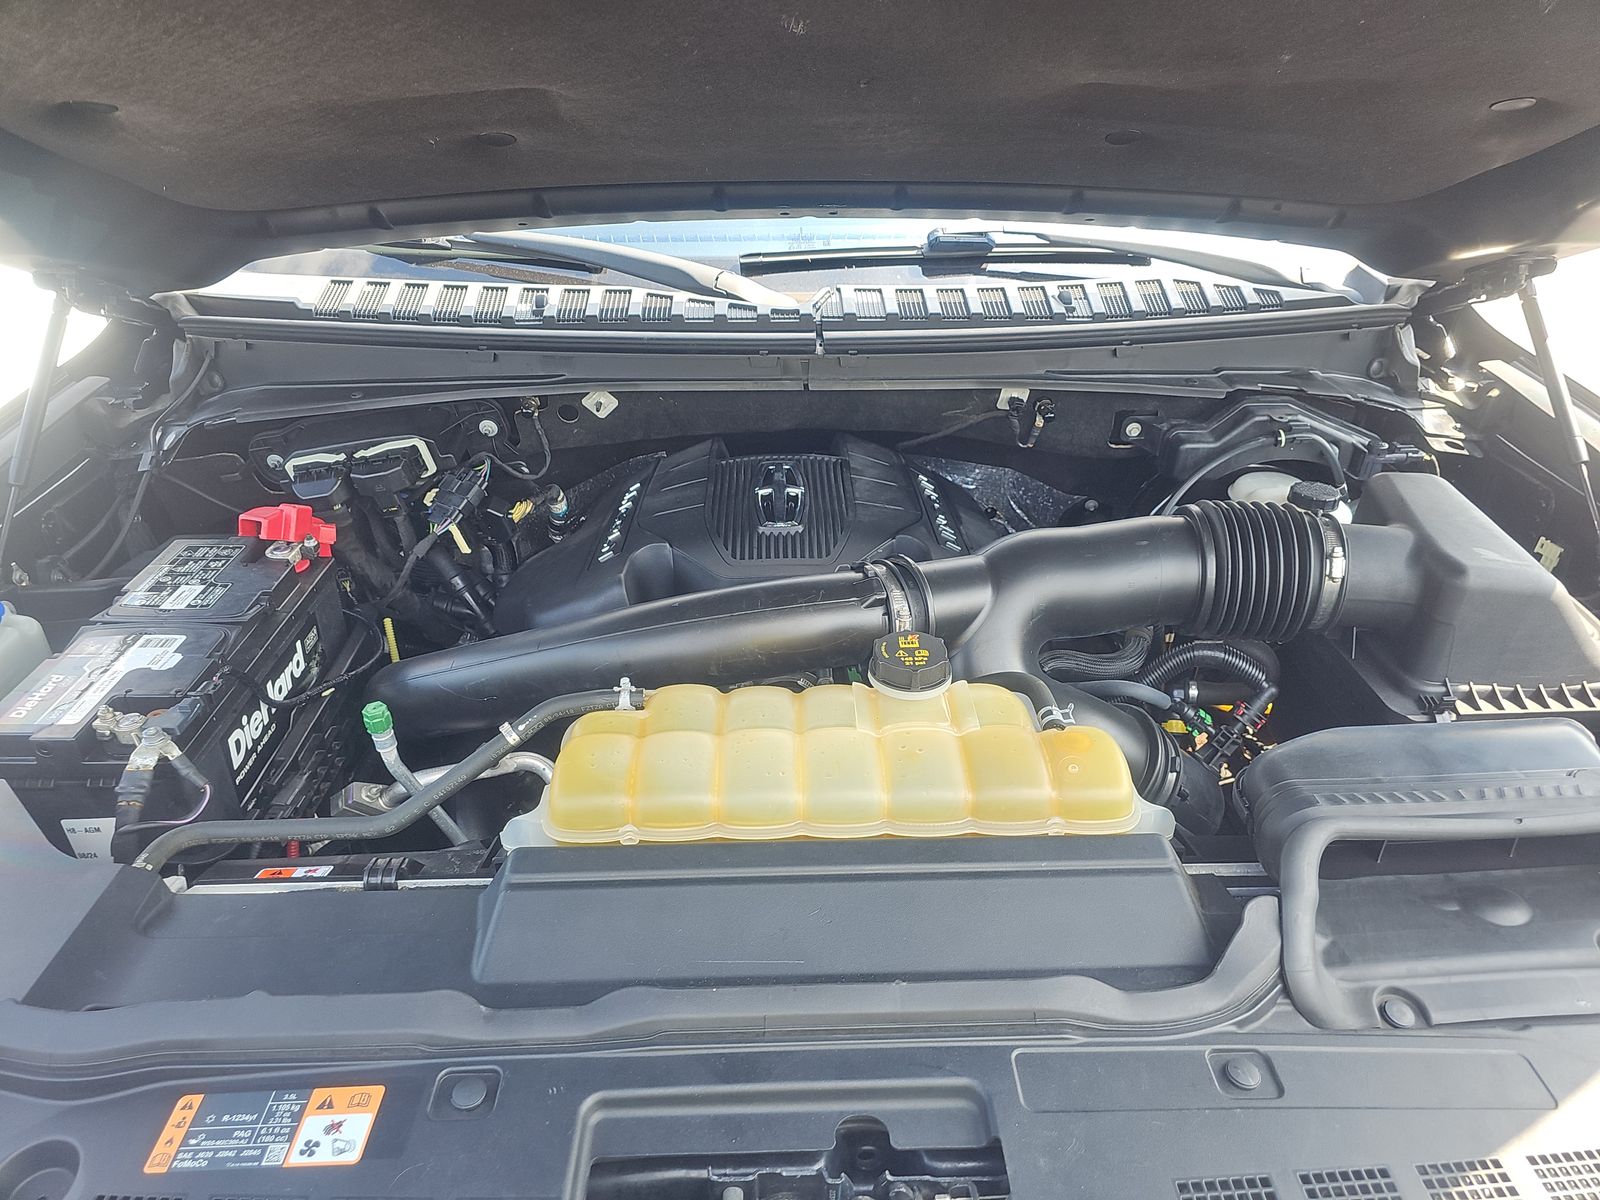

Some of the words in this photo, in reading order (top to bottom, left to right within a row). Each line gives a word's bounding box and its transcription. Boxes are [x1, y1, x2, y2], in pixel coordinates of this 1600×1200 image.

[8, 674, 65, 719] DieHard
[228, 639, 306, 771] DieHard
[235, 752, 257, 786] POWER
[257, 722, 277, 755] AHEAD
[290, 1103, 301, 1113] kg
[221, 1112, 259, 1123] R-1234yf
[232, 1129, 252, 1139] PAG
[171, 1158, 209, 1169] FoMoCo
